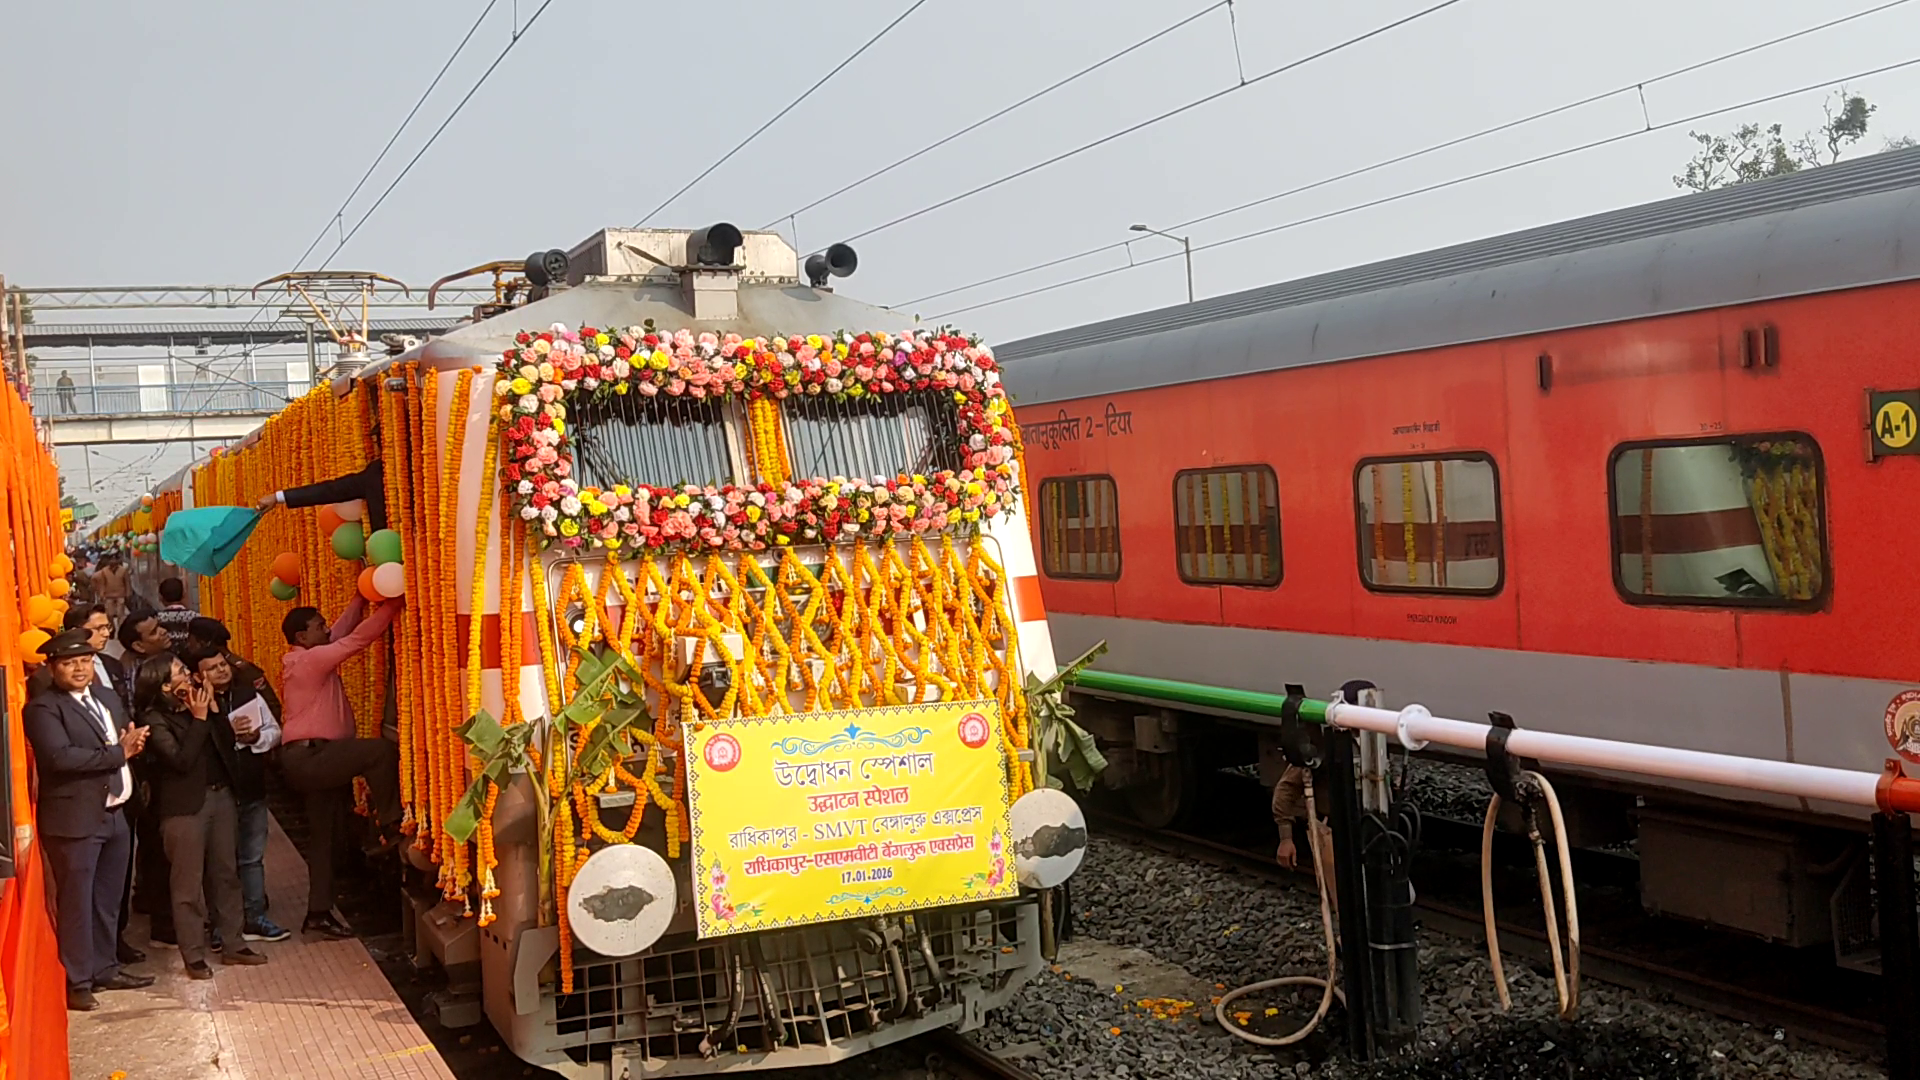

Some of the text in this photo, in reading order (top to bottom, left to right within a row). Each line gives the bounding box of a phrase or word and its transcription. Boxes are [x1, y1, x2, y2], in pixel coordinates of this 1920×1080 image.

[1021, 409, 1080, 450] वातानुकूलित
[1881, 409, 1910, 439] A-1
[774, 753, 933, 786] উদ্বোধন স্পেশাল
[863, 785, 909, 806] स्पेशल
[728, 826, 797, 849] রাধিকাপুর
[814, 819, 867, 840] SMVT
[842, 867, 893, 884] 17.01.2026
